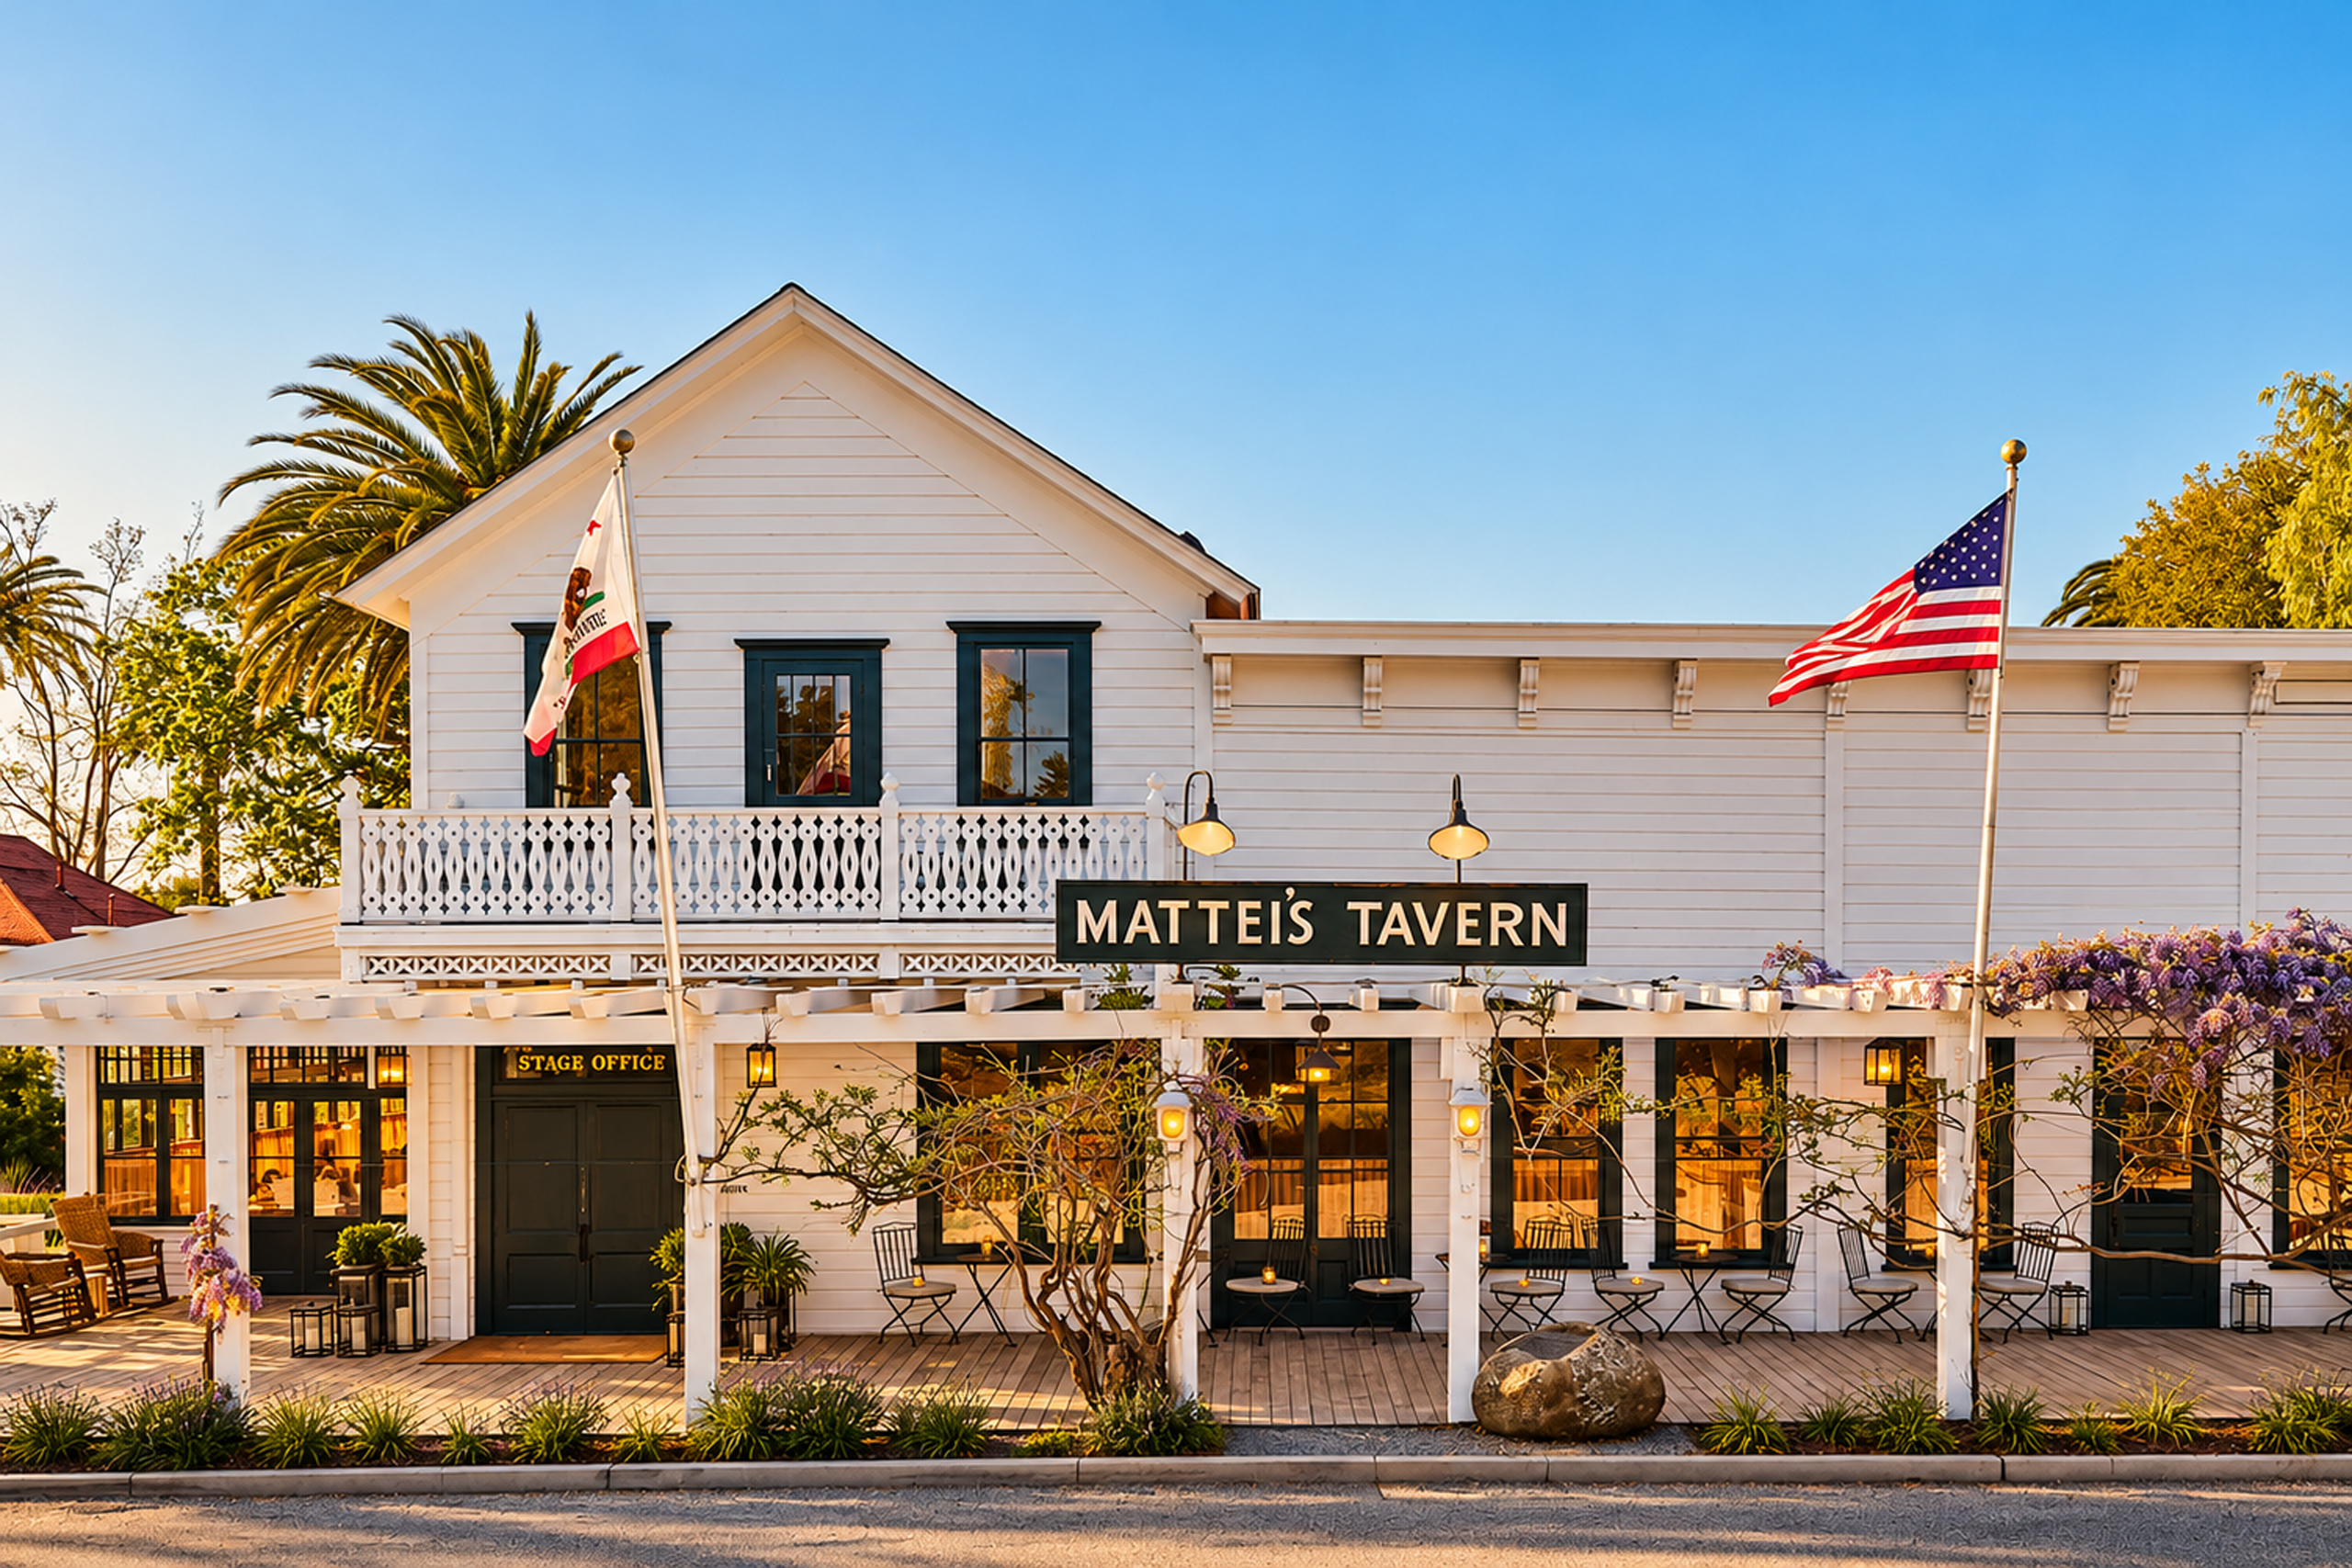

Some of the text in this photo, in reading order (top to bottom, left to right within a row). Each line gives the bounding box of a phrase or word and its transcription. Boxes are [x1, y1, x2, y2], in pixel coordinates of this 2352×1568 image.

[1076, 886, 1567, 947] MATTEI'S TAVERN
[518, 1055, 666, 1071] STAGE OFFICE
